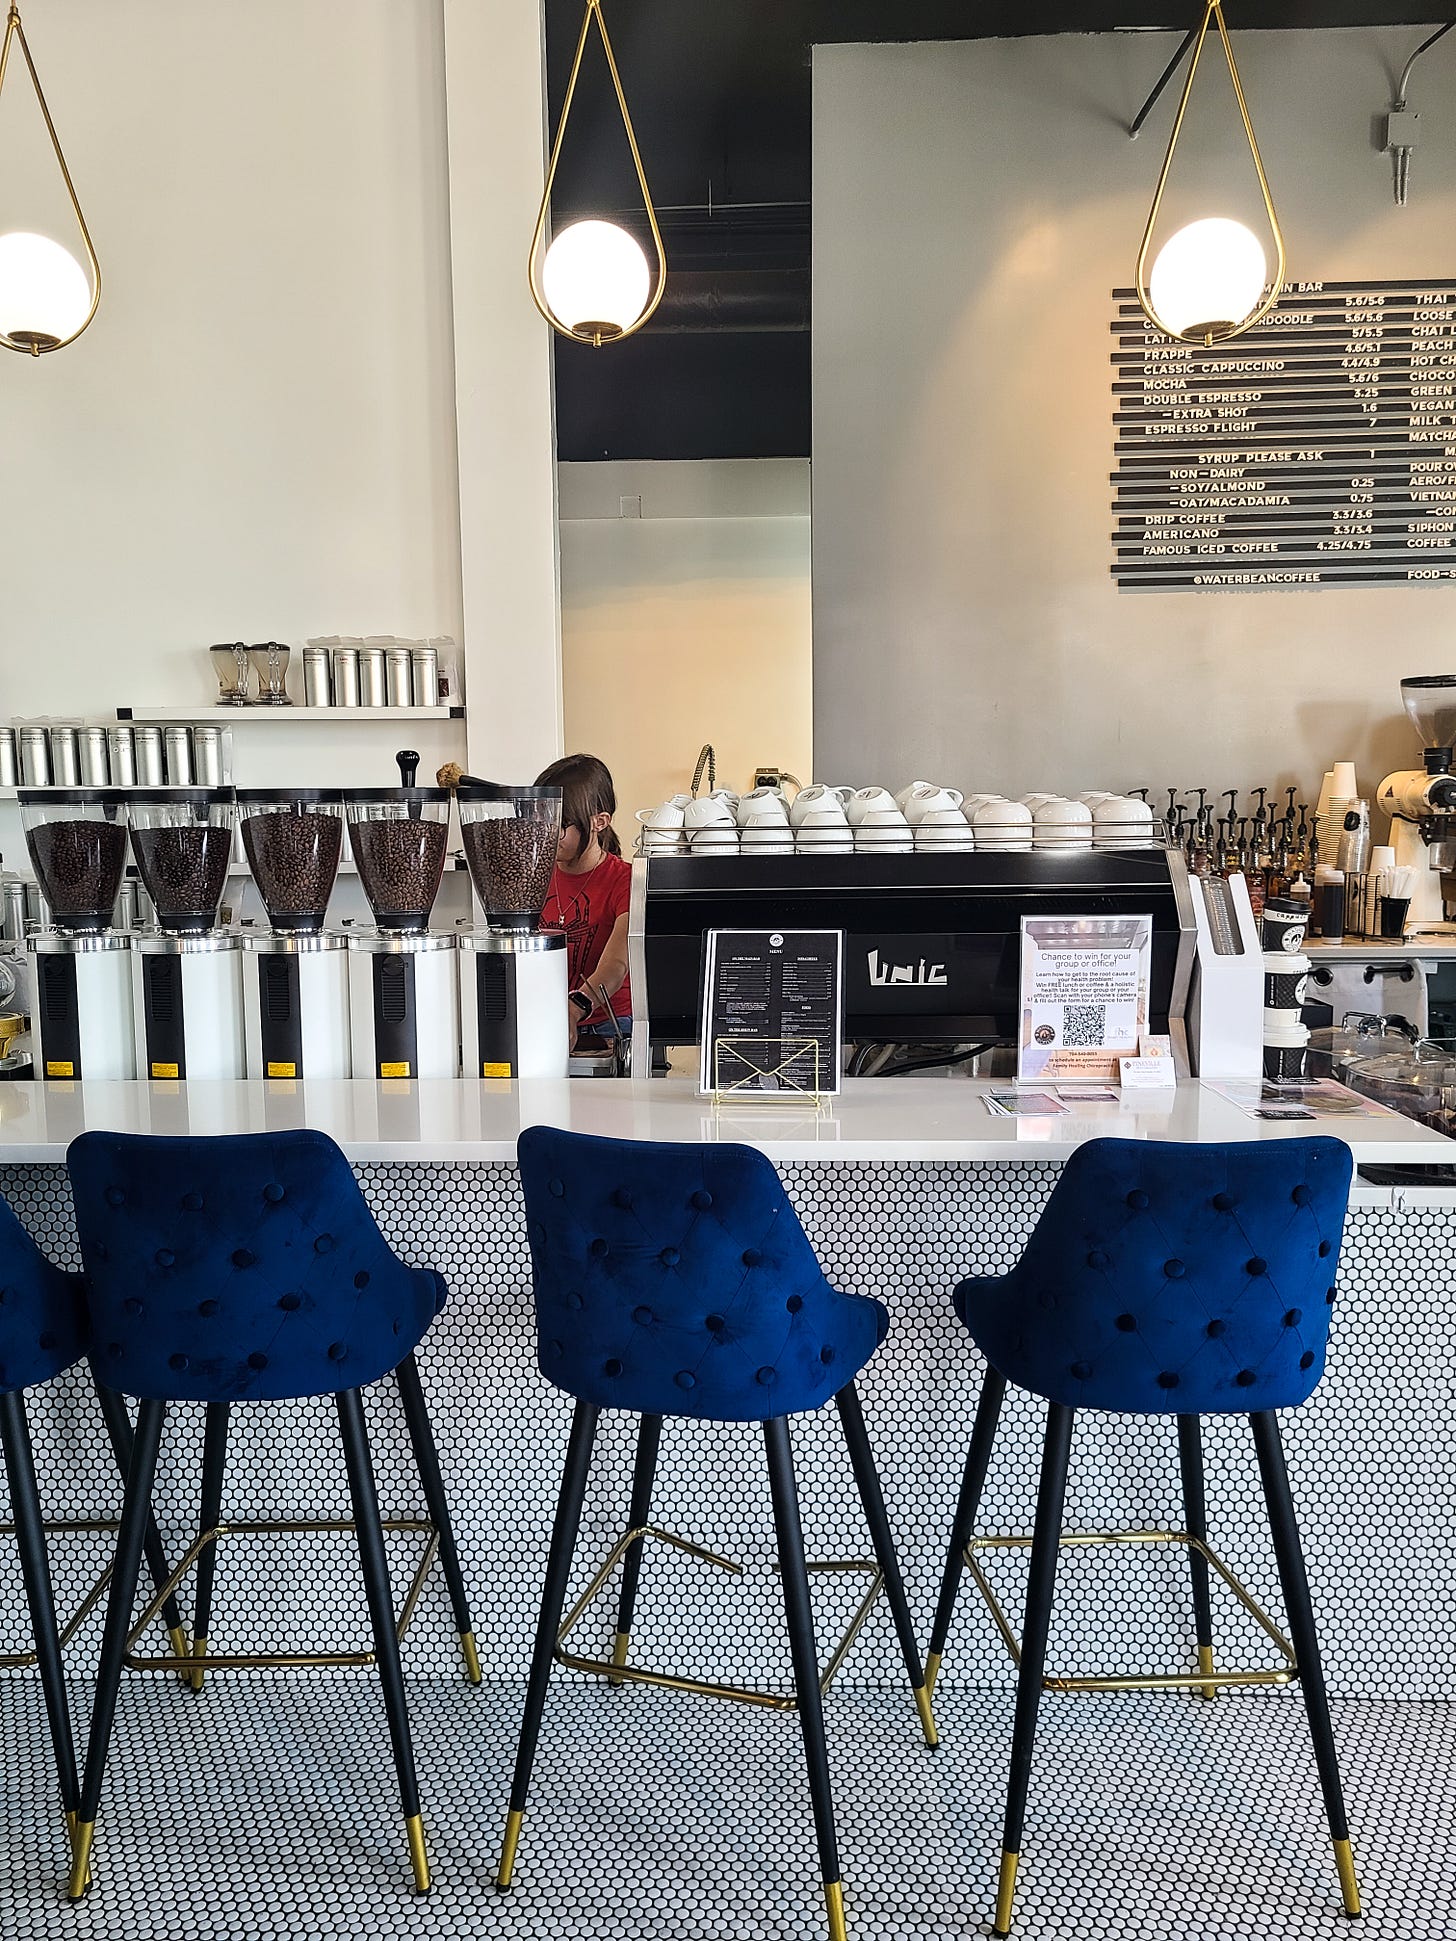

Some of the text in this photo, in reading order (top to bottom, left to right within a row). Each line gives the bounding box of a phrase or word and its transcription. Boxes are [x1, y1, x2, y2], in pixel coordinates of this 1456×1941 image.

[1264, 282, 1323, 293] MIN BAR
[1345, 297, 1385, 306] 5.6/5.6
[1415, 295, 1447, 304] THAI
[1345, 313, 1383, 323] 5.6/5.6
[1413, 310, 1453, 320] LOOSE
[1352, 328, 1383, 338] 5/5.5
[1411, 326, 1444, 336] CHAI
[1411, 341, 1453, 351] PEACH
[1144, 343, 1380, 360] FRAPPE 4.6/5.1
[1410, 356, 1436, 366] HOT
[1143, 358, 1380, 375] CLASSIC CAPPUCCINO 4.4/4.9
[1143, 373, 1380, 390] MOCHA 5.6/6
[1410, 386, 1453, 396] GREEN
[1143, 388, 1379, 405] DOUBLE ESPRESSO 3.25
[1217, 407, 1248, 417] SHOT
[1361, 403, 1378, 413] 1.6
[1410, 401, 1454, 411] VEGAN
[1145, 418, 1377, 434] ESPRESSO FLIGHT 7
[1409, 416, 1441, 426] MILK
[1198, 454, 1239, 464] SYRUP
[1246, 452, 1292, 462] PLEASE
[1297, 451, 1323, 461] ASK
[1409, 462, 1442, 472] POUR
[1351, 478, 1375, 488] 0.25
[1350, 493, 1374, 503] 0.75
[1145, 509, 1373, 525] DRIP COFFEE 3.3/3.6
[1143, 525, 1373, 540] AMERICANO 3.3/3.4
[1407, 522, 1454, 533] SIPHON
[1143, 540, 1372, 556] FAMOUS ICED COFFEE 4.25/4.75
[1406, 538, 1452, 548] COFFEE
[1193, 572, 1321, 584] @WATERBEANCOFFEE
[1041, 953, 1072, 961] Chance
[1114, 953, 1131, 962] your
[1055, 961, 1079, 969] group
[1091, 960, 1117, 968] office!
